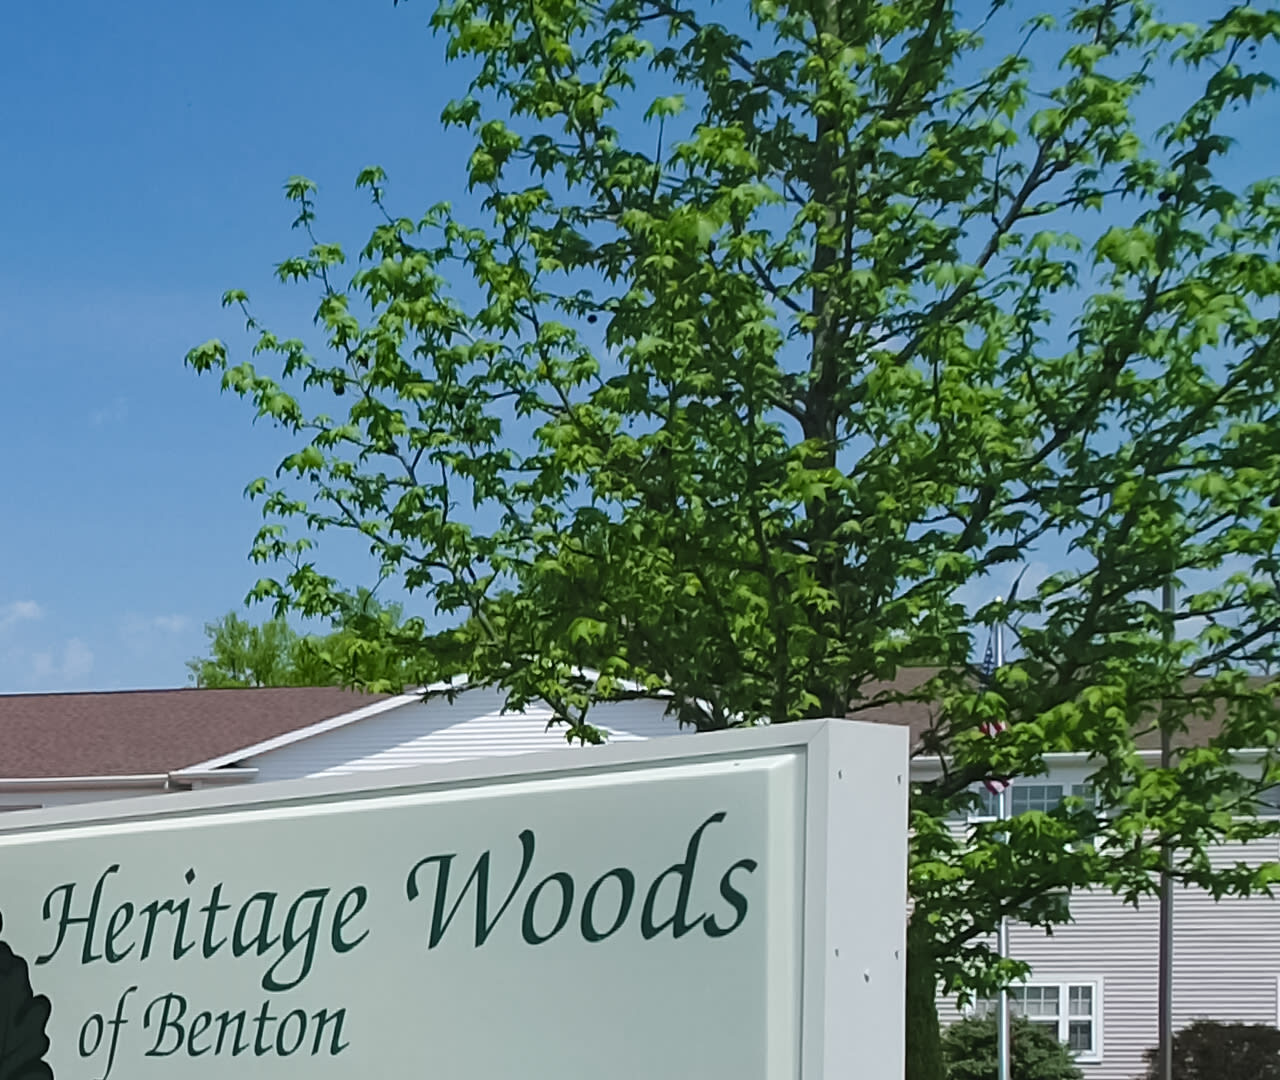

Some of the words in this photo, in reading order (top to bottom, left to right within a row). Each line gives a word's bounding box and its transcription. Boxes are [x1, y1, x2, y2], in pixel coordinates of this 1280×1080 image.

[35, 864, 369, 991] Heritage
[406, 811, 758, 950] Woods
[143, 992, 350, 1058] Benton
